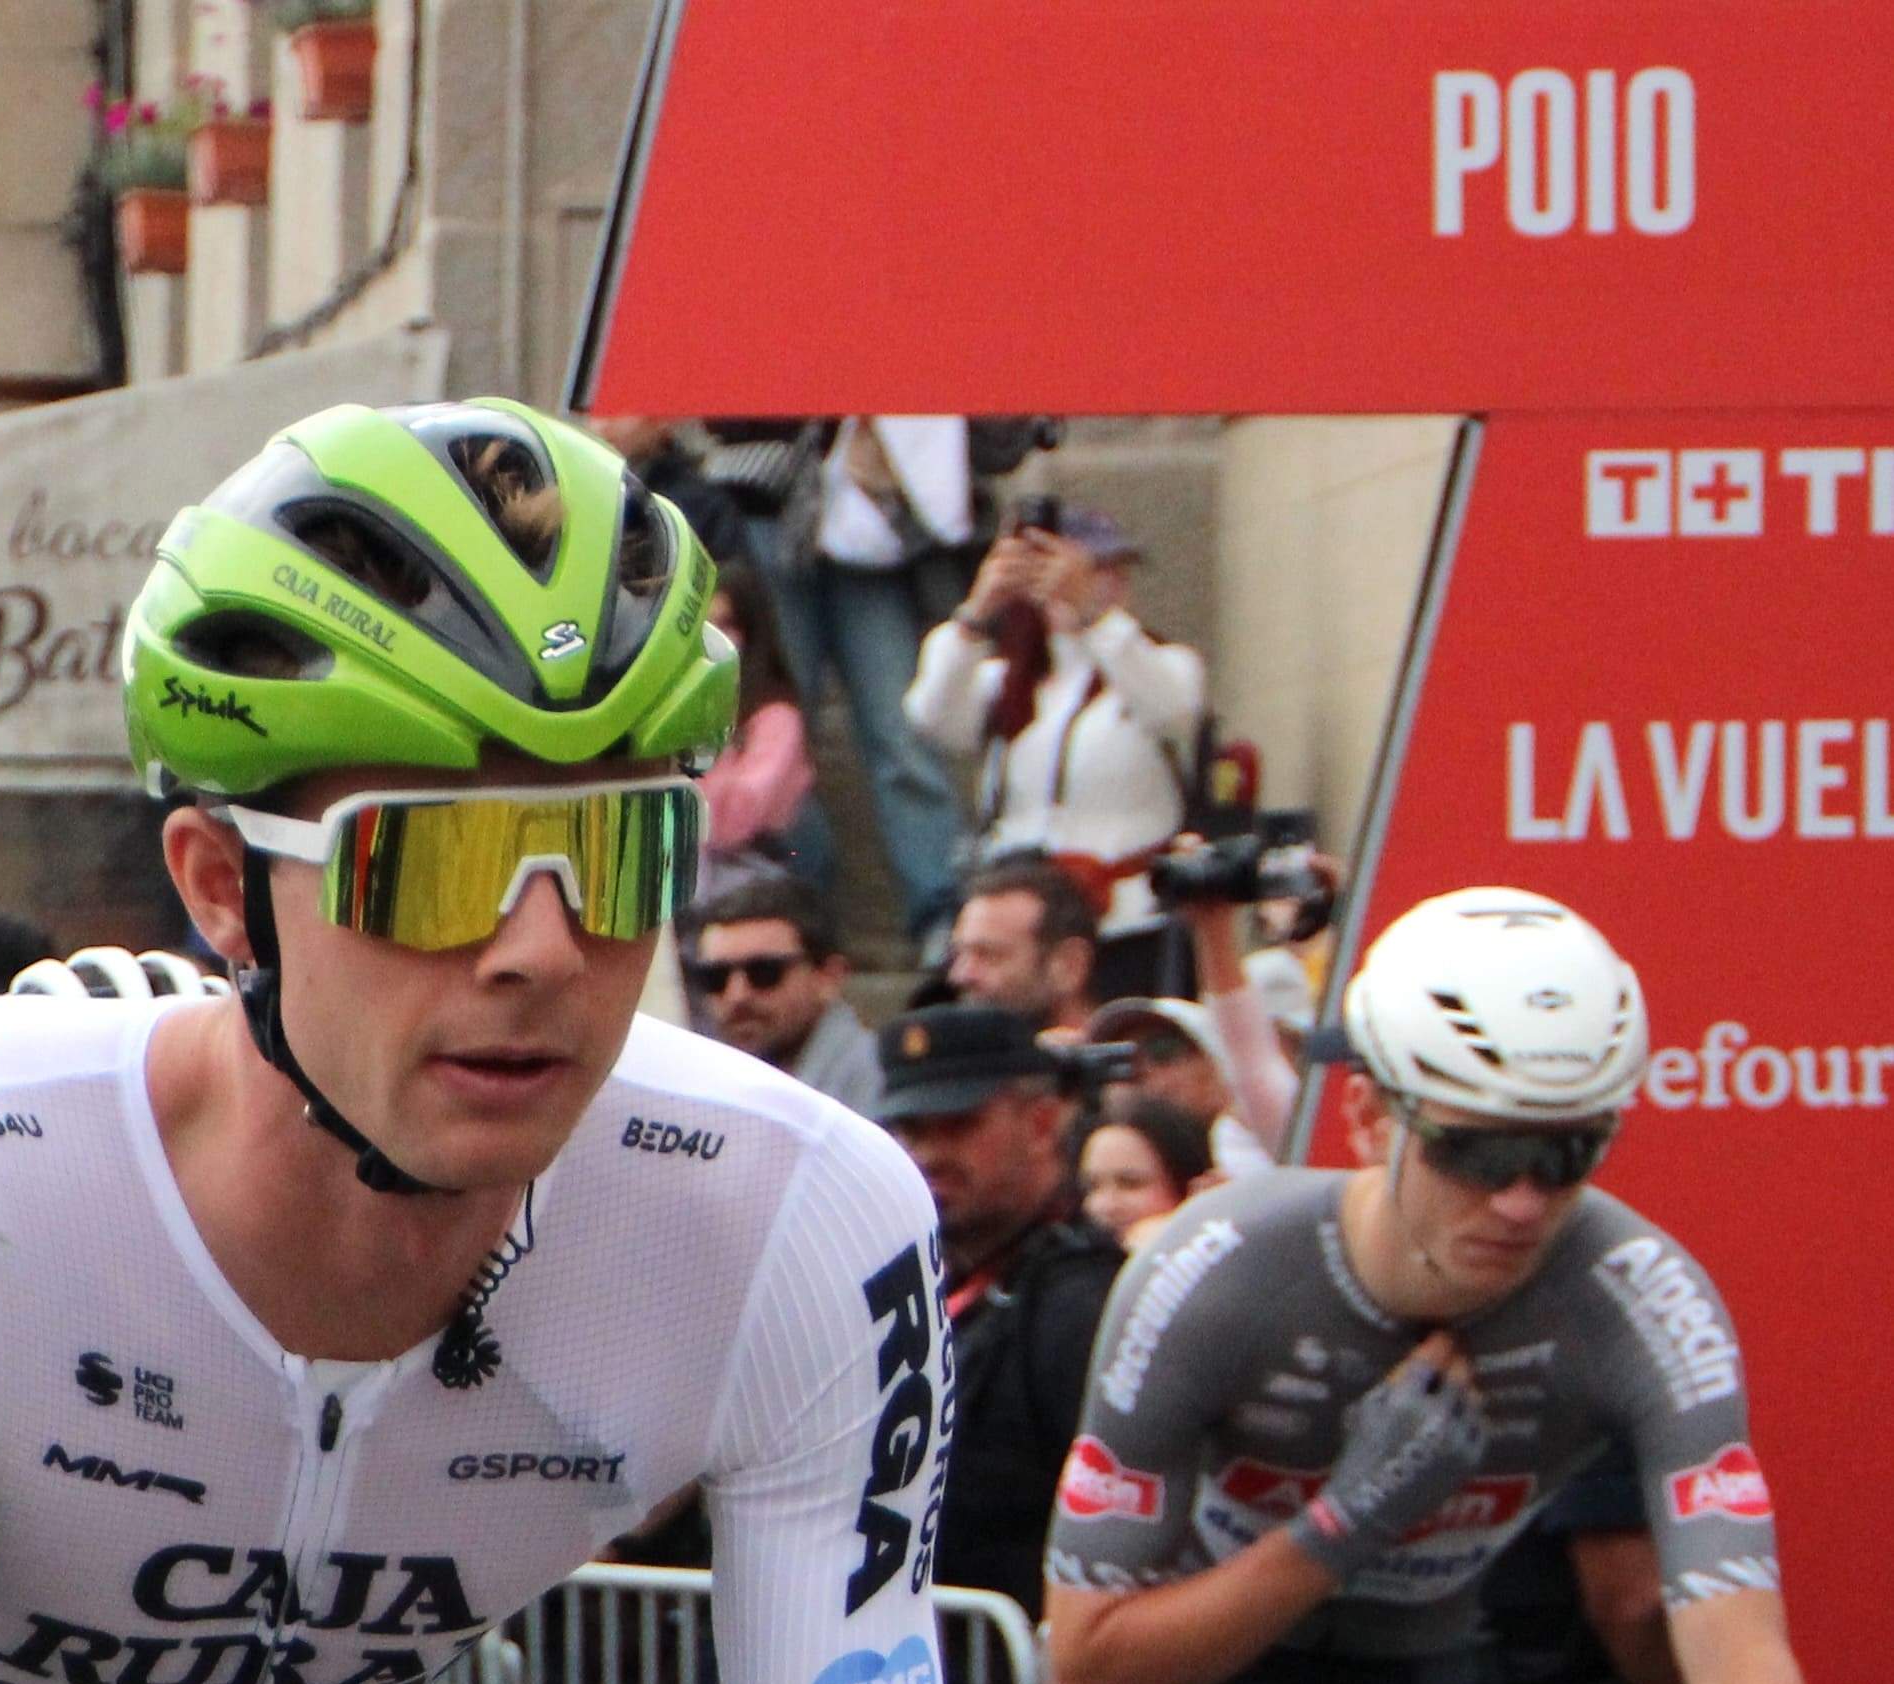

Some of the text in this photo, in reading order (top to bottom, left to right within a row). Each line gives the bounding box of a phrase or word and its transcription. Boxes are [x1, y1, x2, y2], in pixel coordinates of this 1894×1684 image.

[1432, 66, 1697, 236] POIO
[321, 592, 397, 652] RURAL
[1508, 721, 1630, 840] LA
[621, 1116, 724, 1161] BED4U
[134, 1385, 173, 1409] PRO
[135, 1366, 174, 1391] UCI
[134, 1406, 184, 1431] TEAM
[845, 1241, 933, 1618] RGA
[42, 1444, 207, 1503] MMR
[447, 1453, 627, 1483] GSPORT
[133, 1543, 488, 1634] CAJA
